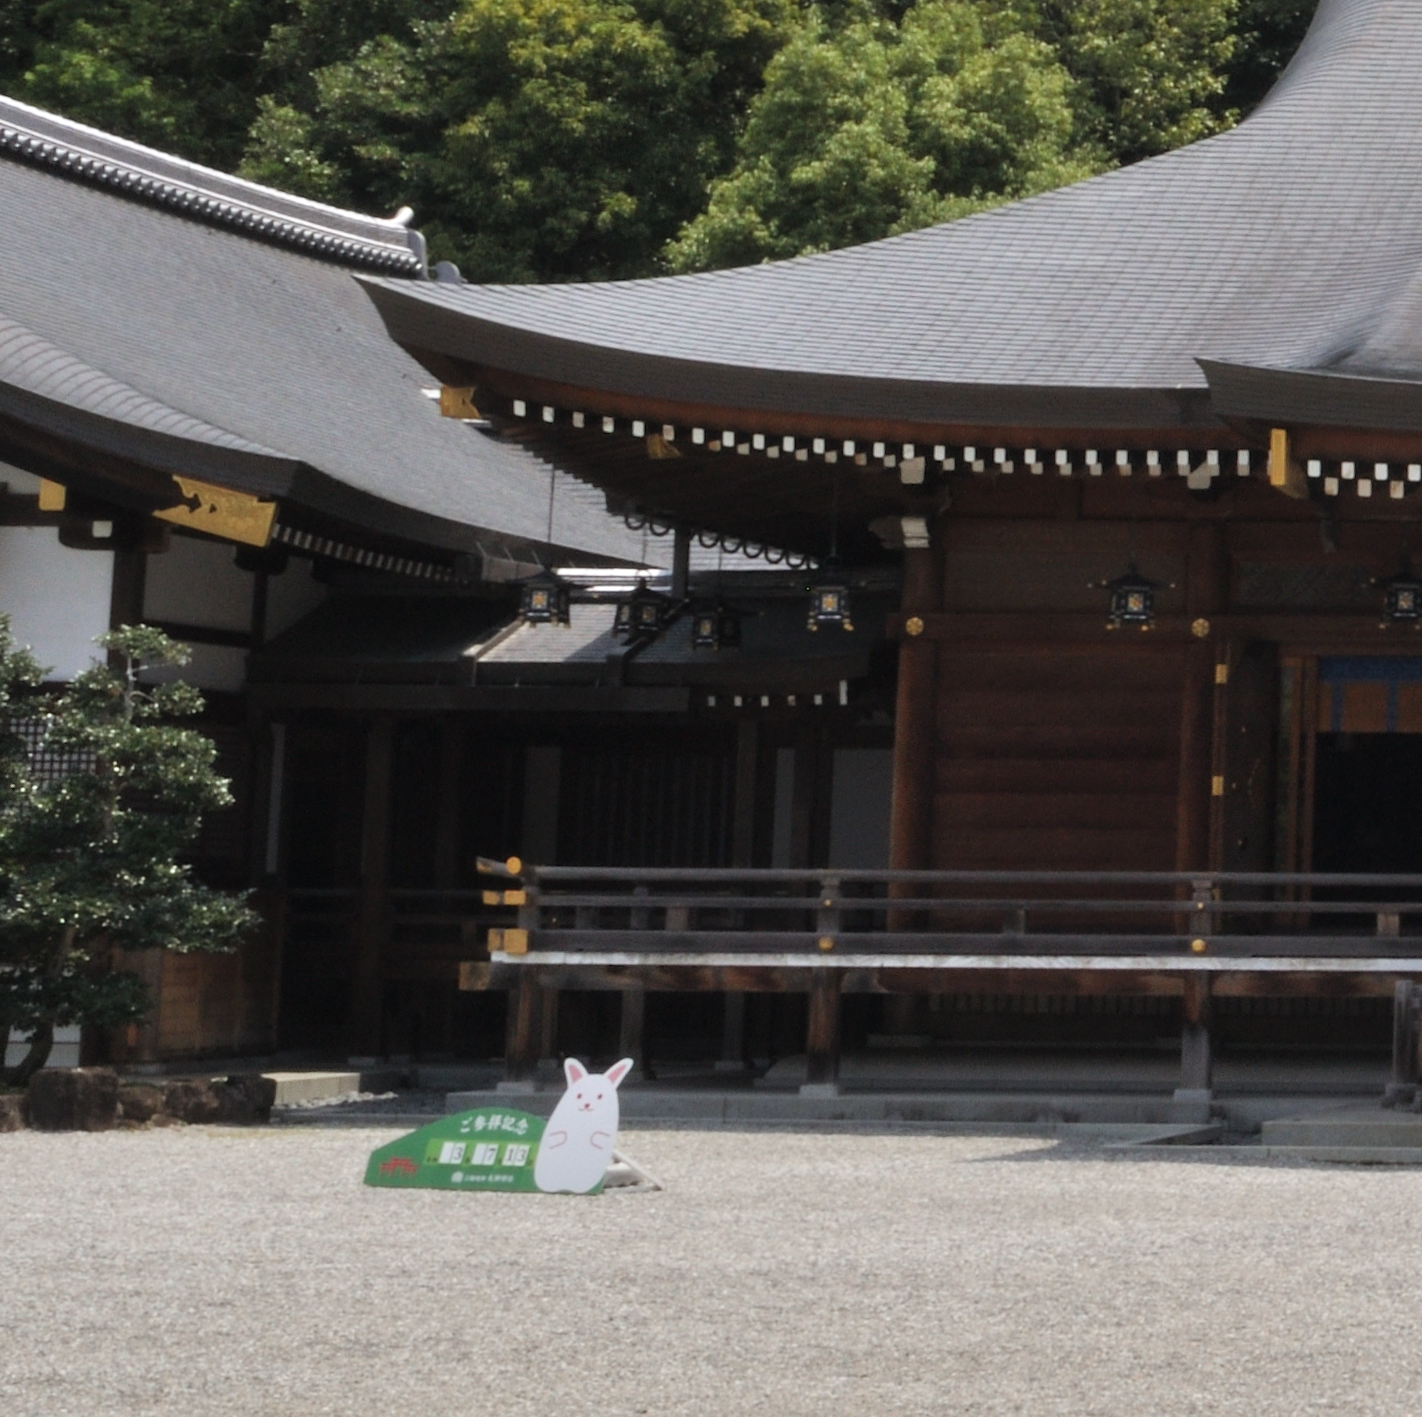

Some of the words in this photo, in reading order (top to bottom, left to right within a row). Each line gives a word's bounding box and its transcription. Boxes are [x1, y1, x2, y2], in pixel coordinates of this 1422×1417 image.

[460, 1114, 528, 1136] ご参拝記念
[454, 1146, 463, 1160] 3
[487, 1148, 496, 1161] 7
[506, 1148, 526, 1162] 13
